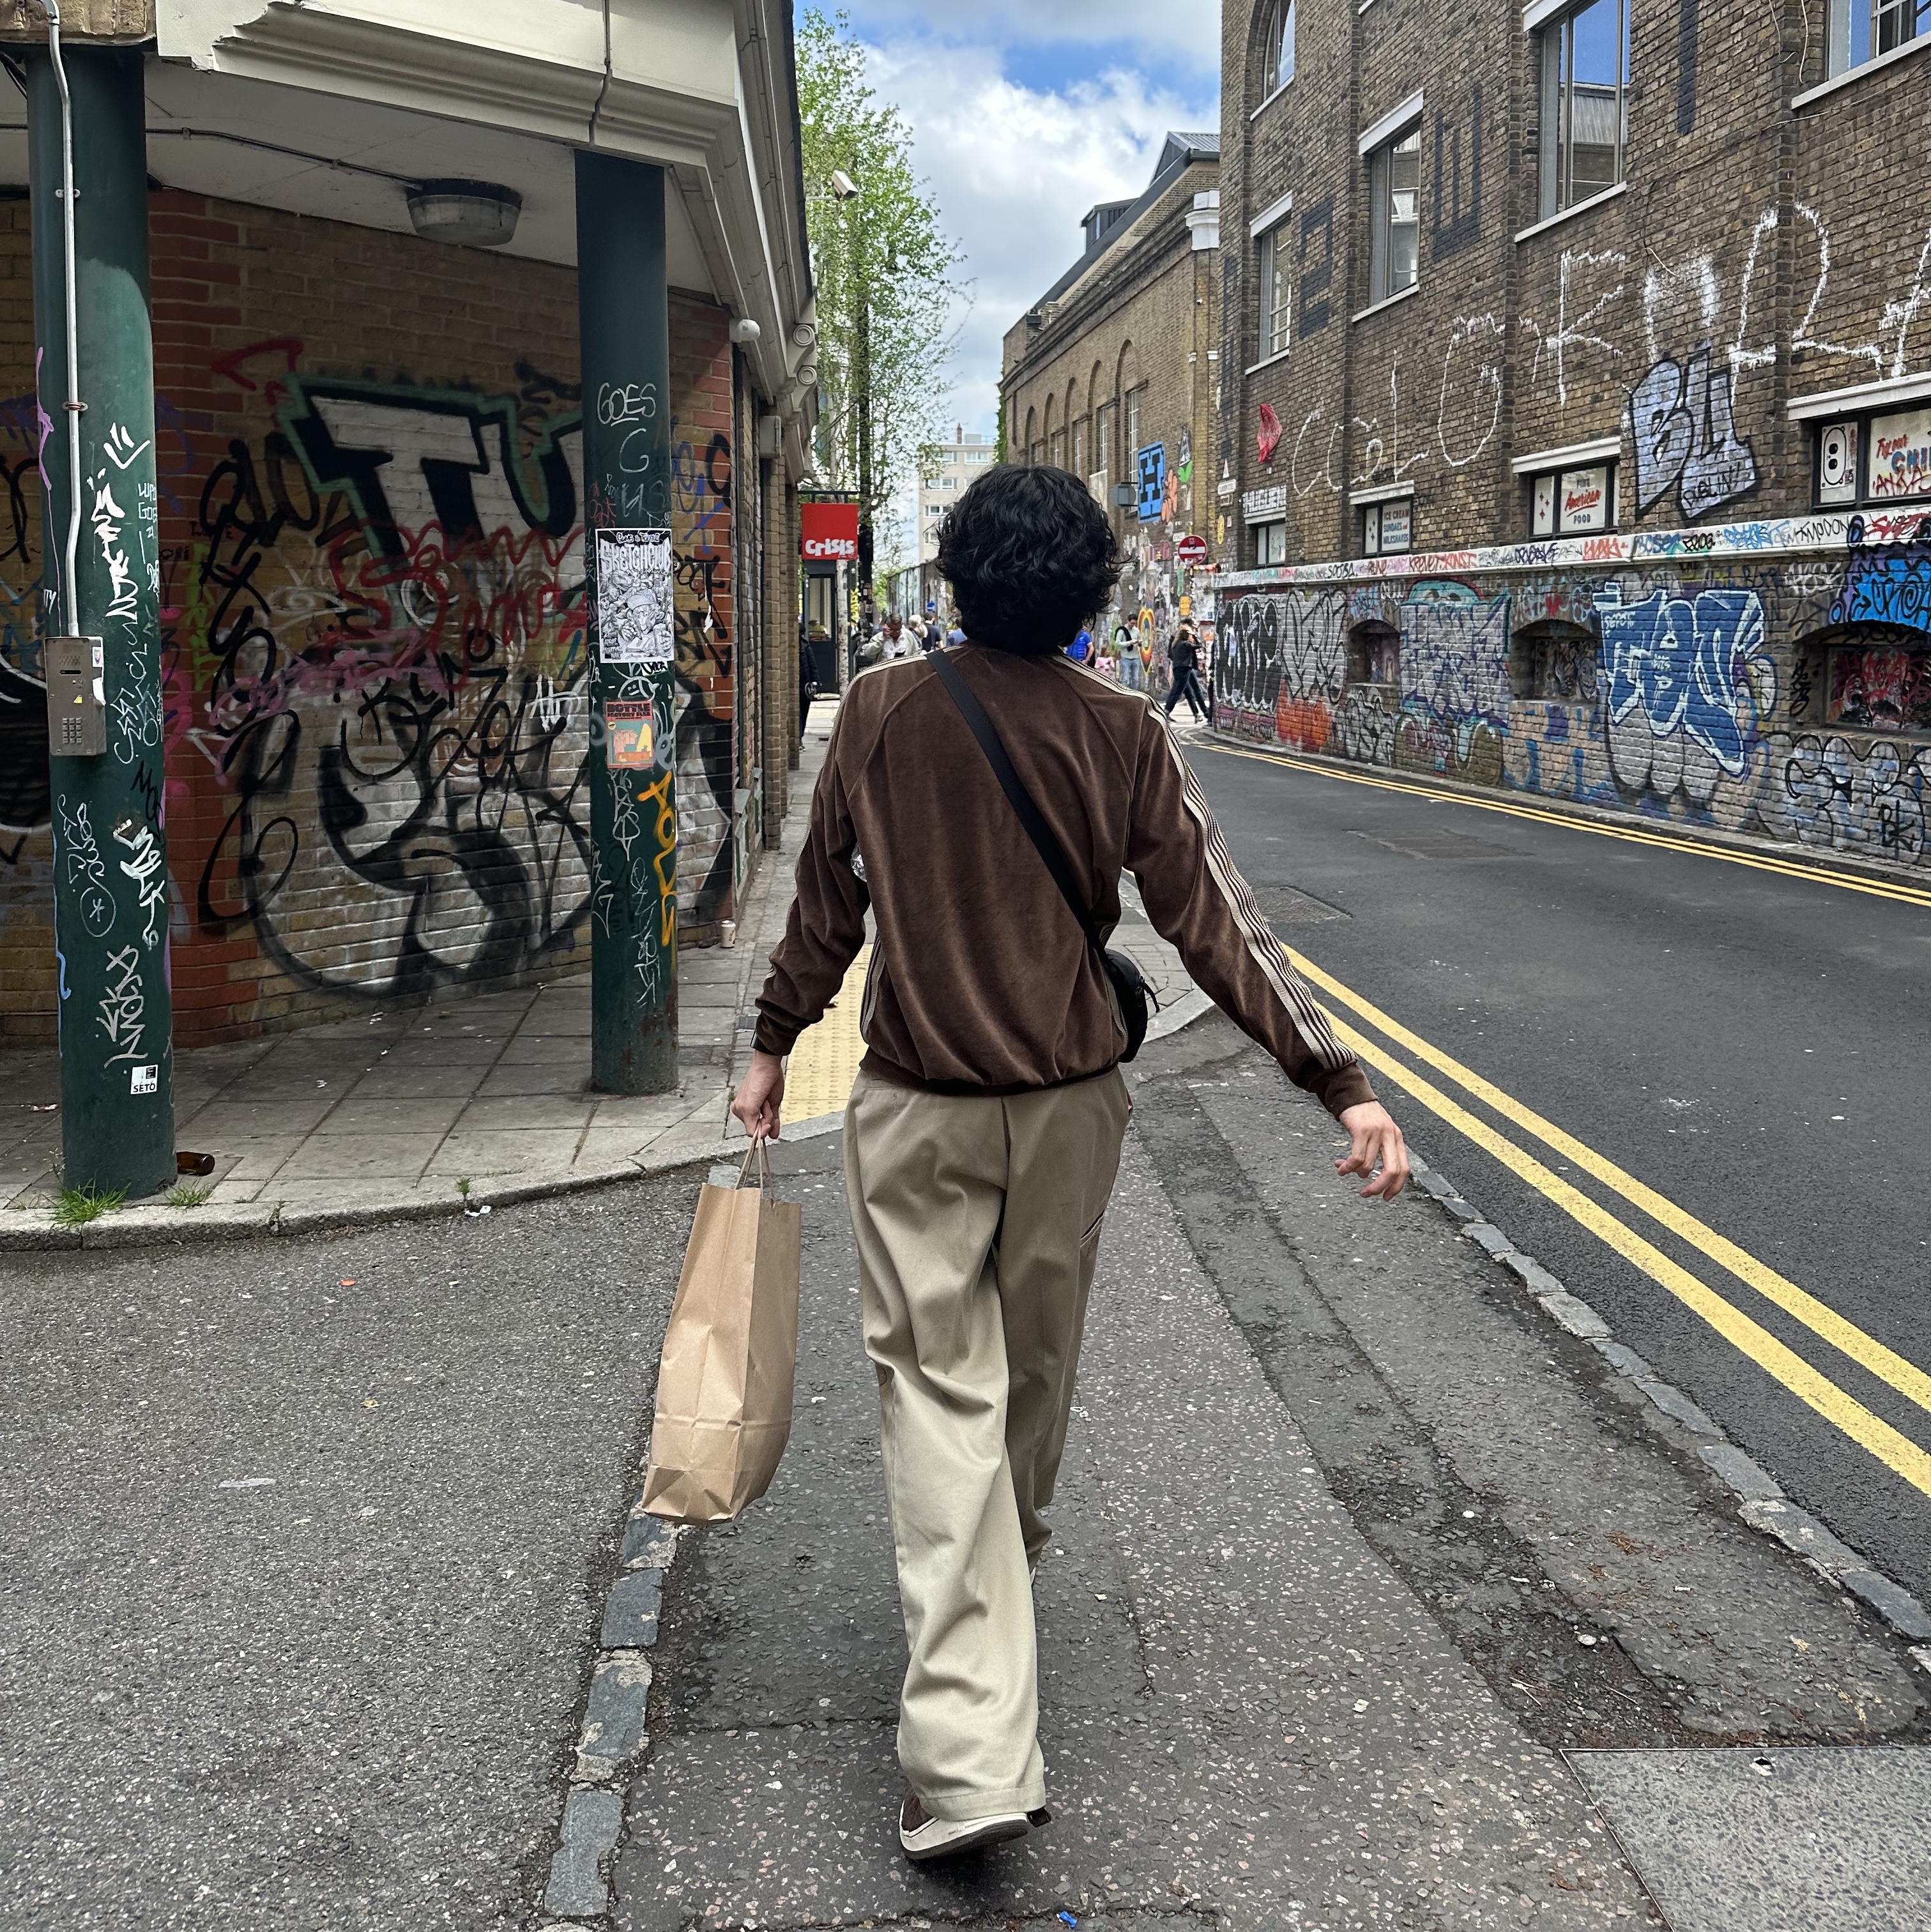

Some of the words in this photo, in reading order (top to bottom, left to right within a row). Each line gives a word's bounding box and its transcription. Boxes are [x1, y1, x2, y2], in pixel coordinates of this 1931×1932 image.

[597, 382, 657, 425] GOES
[1891, 446, 1931, 474] CHI
[1564, 489, 1601, 512] American
[1393, 508, 1409, 520] CREAM
[1573, 513, 1591, 524] FOOD
[1384, 522, 1403, 533] SUNDAES
[805, 538, 855, 557] Crisis
